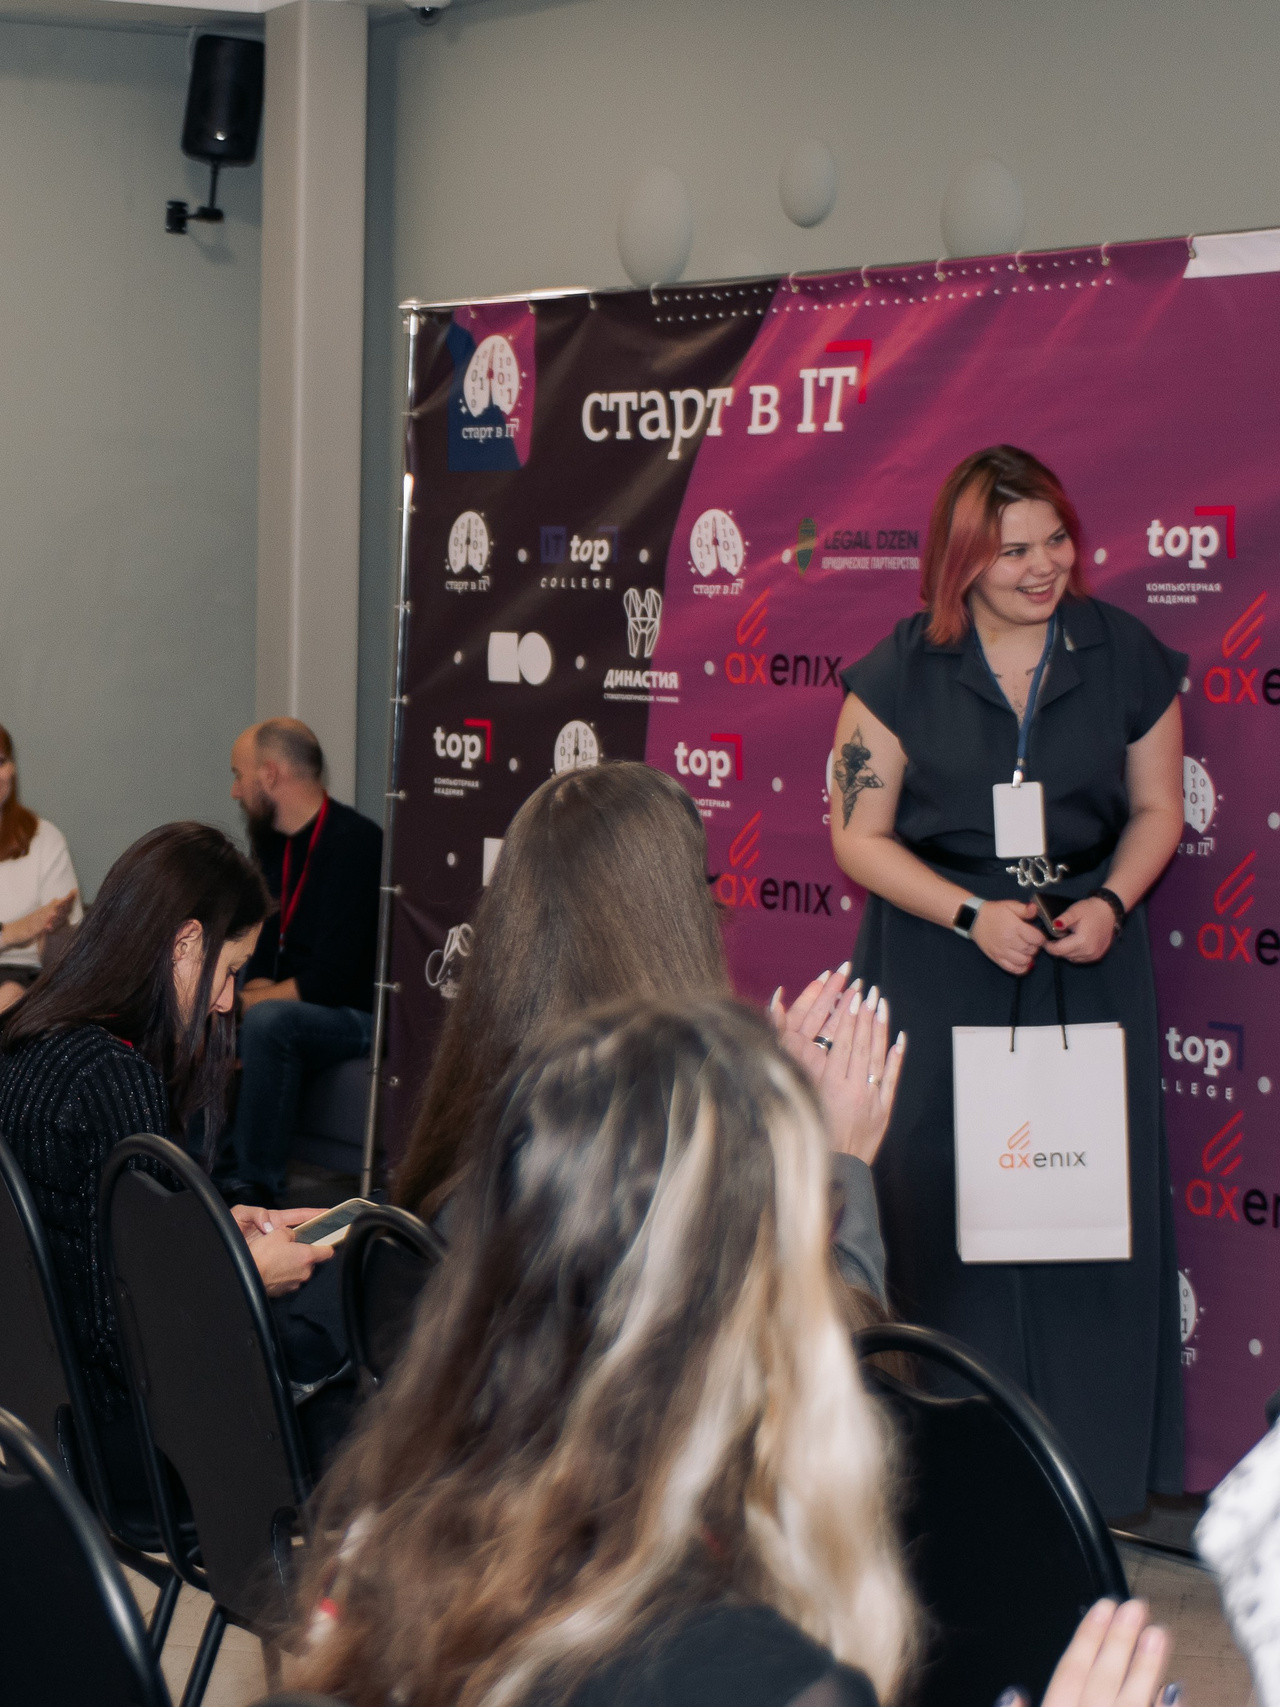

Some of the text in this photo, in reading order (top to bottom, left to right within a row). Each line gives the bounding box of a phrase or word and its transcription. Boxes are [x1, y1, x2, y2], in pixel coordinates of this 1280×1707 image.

[582, 366, 857, 460] старт в IT
[462, 426, 494, 443] старт
[505, 423, 516, 438] IT
[824, 530, 919, 550] LEGAL DZEN
[1146, 519, 1220, 569] top
[570, 534, 610, 571] top
[445, 580, 469, 595] старт
[540, 577, 612, 589] COLLEGE
[693, 583, 721, 598] старт
[1146, 583, 1221, 593] КОМПЬЮТЕРНАЯ
[1147, 595, 1198, 604] АКАДЕМИЯ
[603, 669, 679, 689] ДИНАСТИЯ
[724, 652, 842, 688] axenix
[433, 726, 481, 769] top
[674, 741, 731, 788] top
[695, 798, 731, 808] ЮТЕРНАЯ
[716, 872, 832, 916] axenix
[1165, 1027, 1231, 1076] top
[1161, 1077, 1233, 1101] LLEGE
[998, 1151, 1086, 1169] axenix
